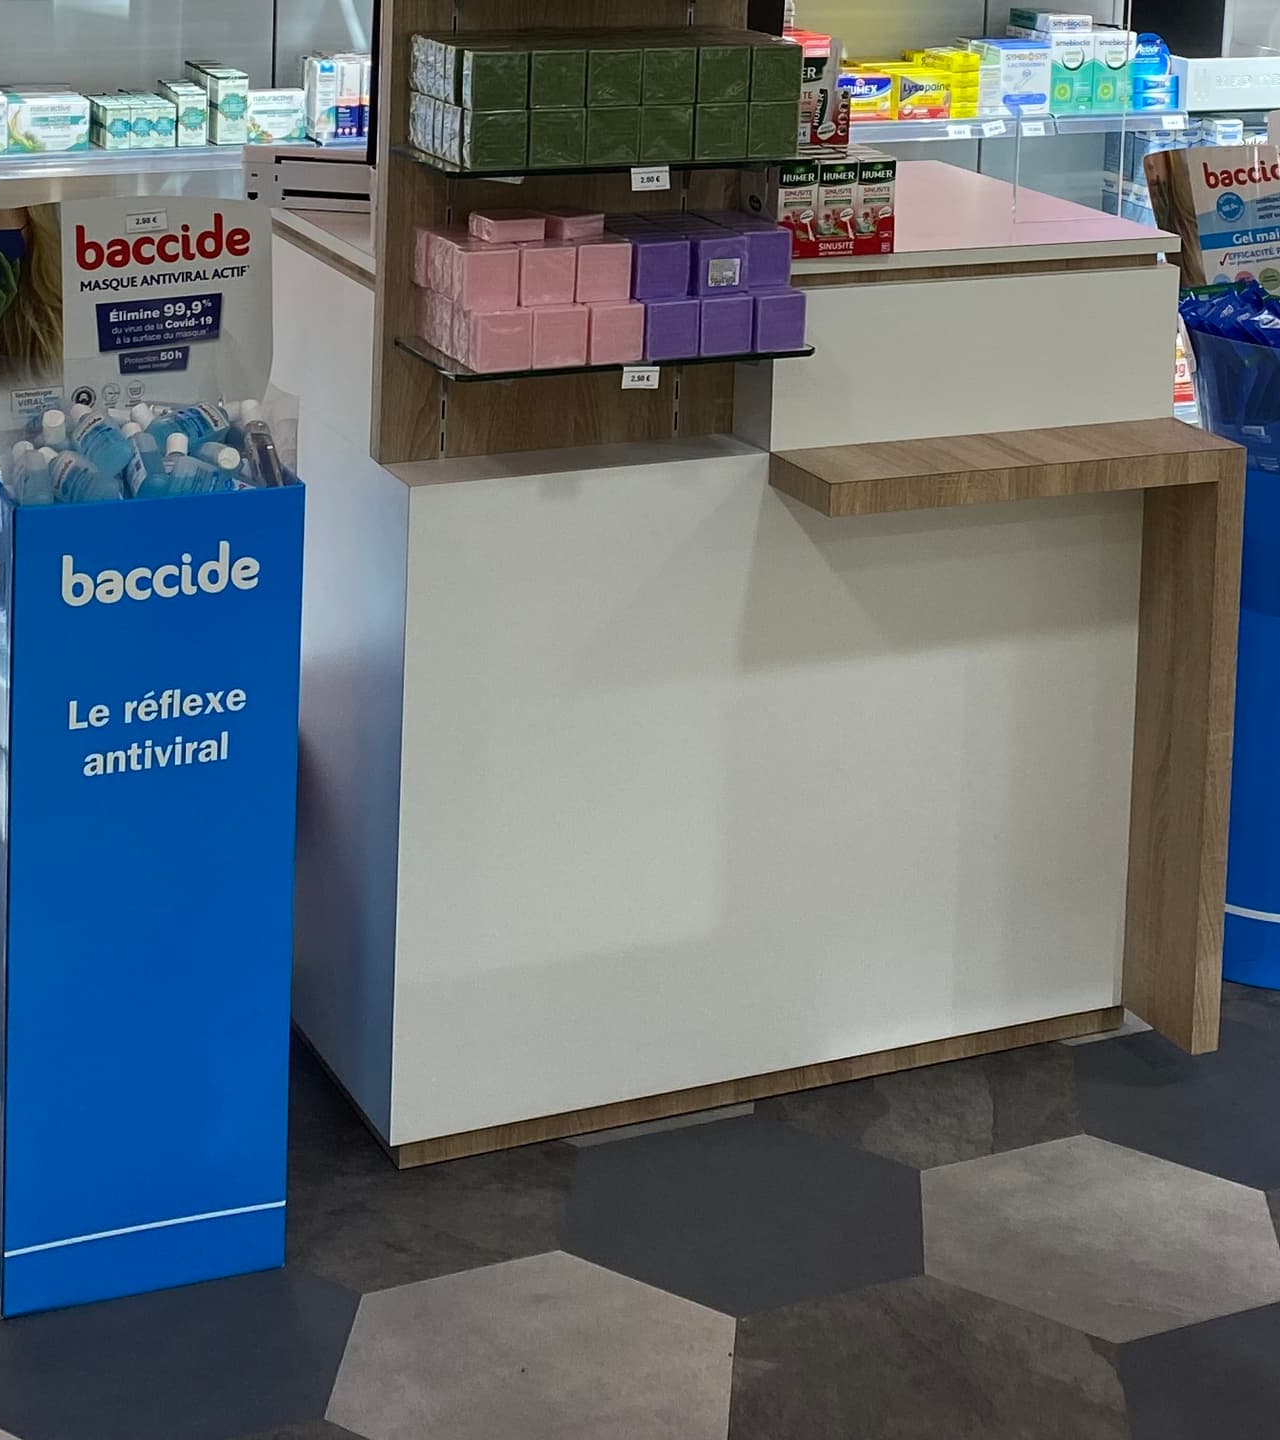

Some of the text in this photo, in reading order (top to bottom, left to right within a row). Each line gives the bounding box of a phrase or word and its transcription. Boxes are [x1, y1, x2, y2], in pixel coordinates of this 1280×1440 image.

[783, 173, 815, 182] HUMER
[823, 171, 855, 181] HUMER
[862, 170, 893, 179] HUMER
[76, 212, 251, 271] baccide
[1233, 232, 1253, 244] Gel
[819, 242, 854, 250] SINUSITE
[80, 276, 137, 292] MASQUE
[140, 272, 209, 287] ANTIVIRAL
[109, 309, 160, 322] Élimine
[112, 327, 122, 335] du
[165, 316, 212, 329] Covid-19
[631, 374, 645, 383] 2.50
[61, 540, 261, 609] baccide
[67, 688, 247, 730] Le réflexe
[83, 733, 230, 778] antiviral
